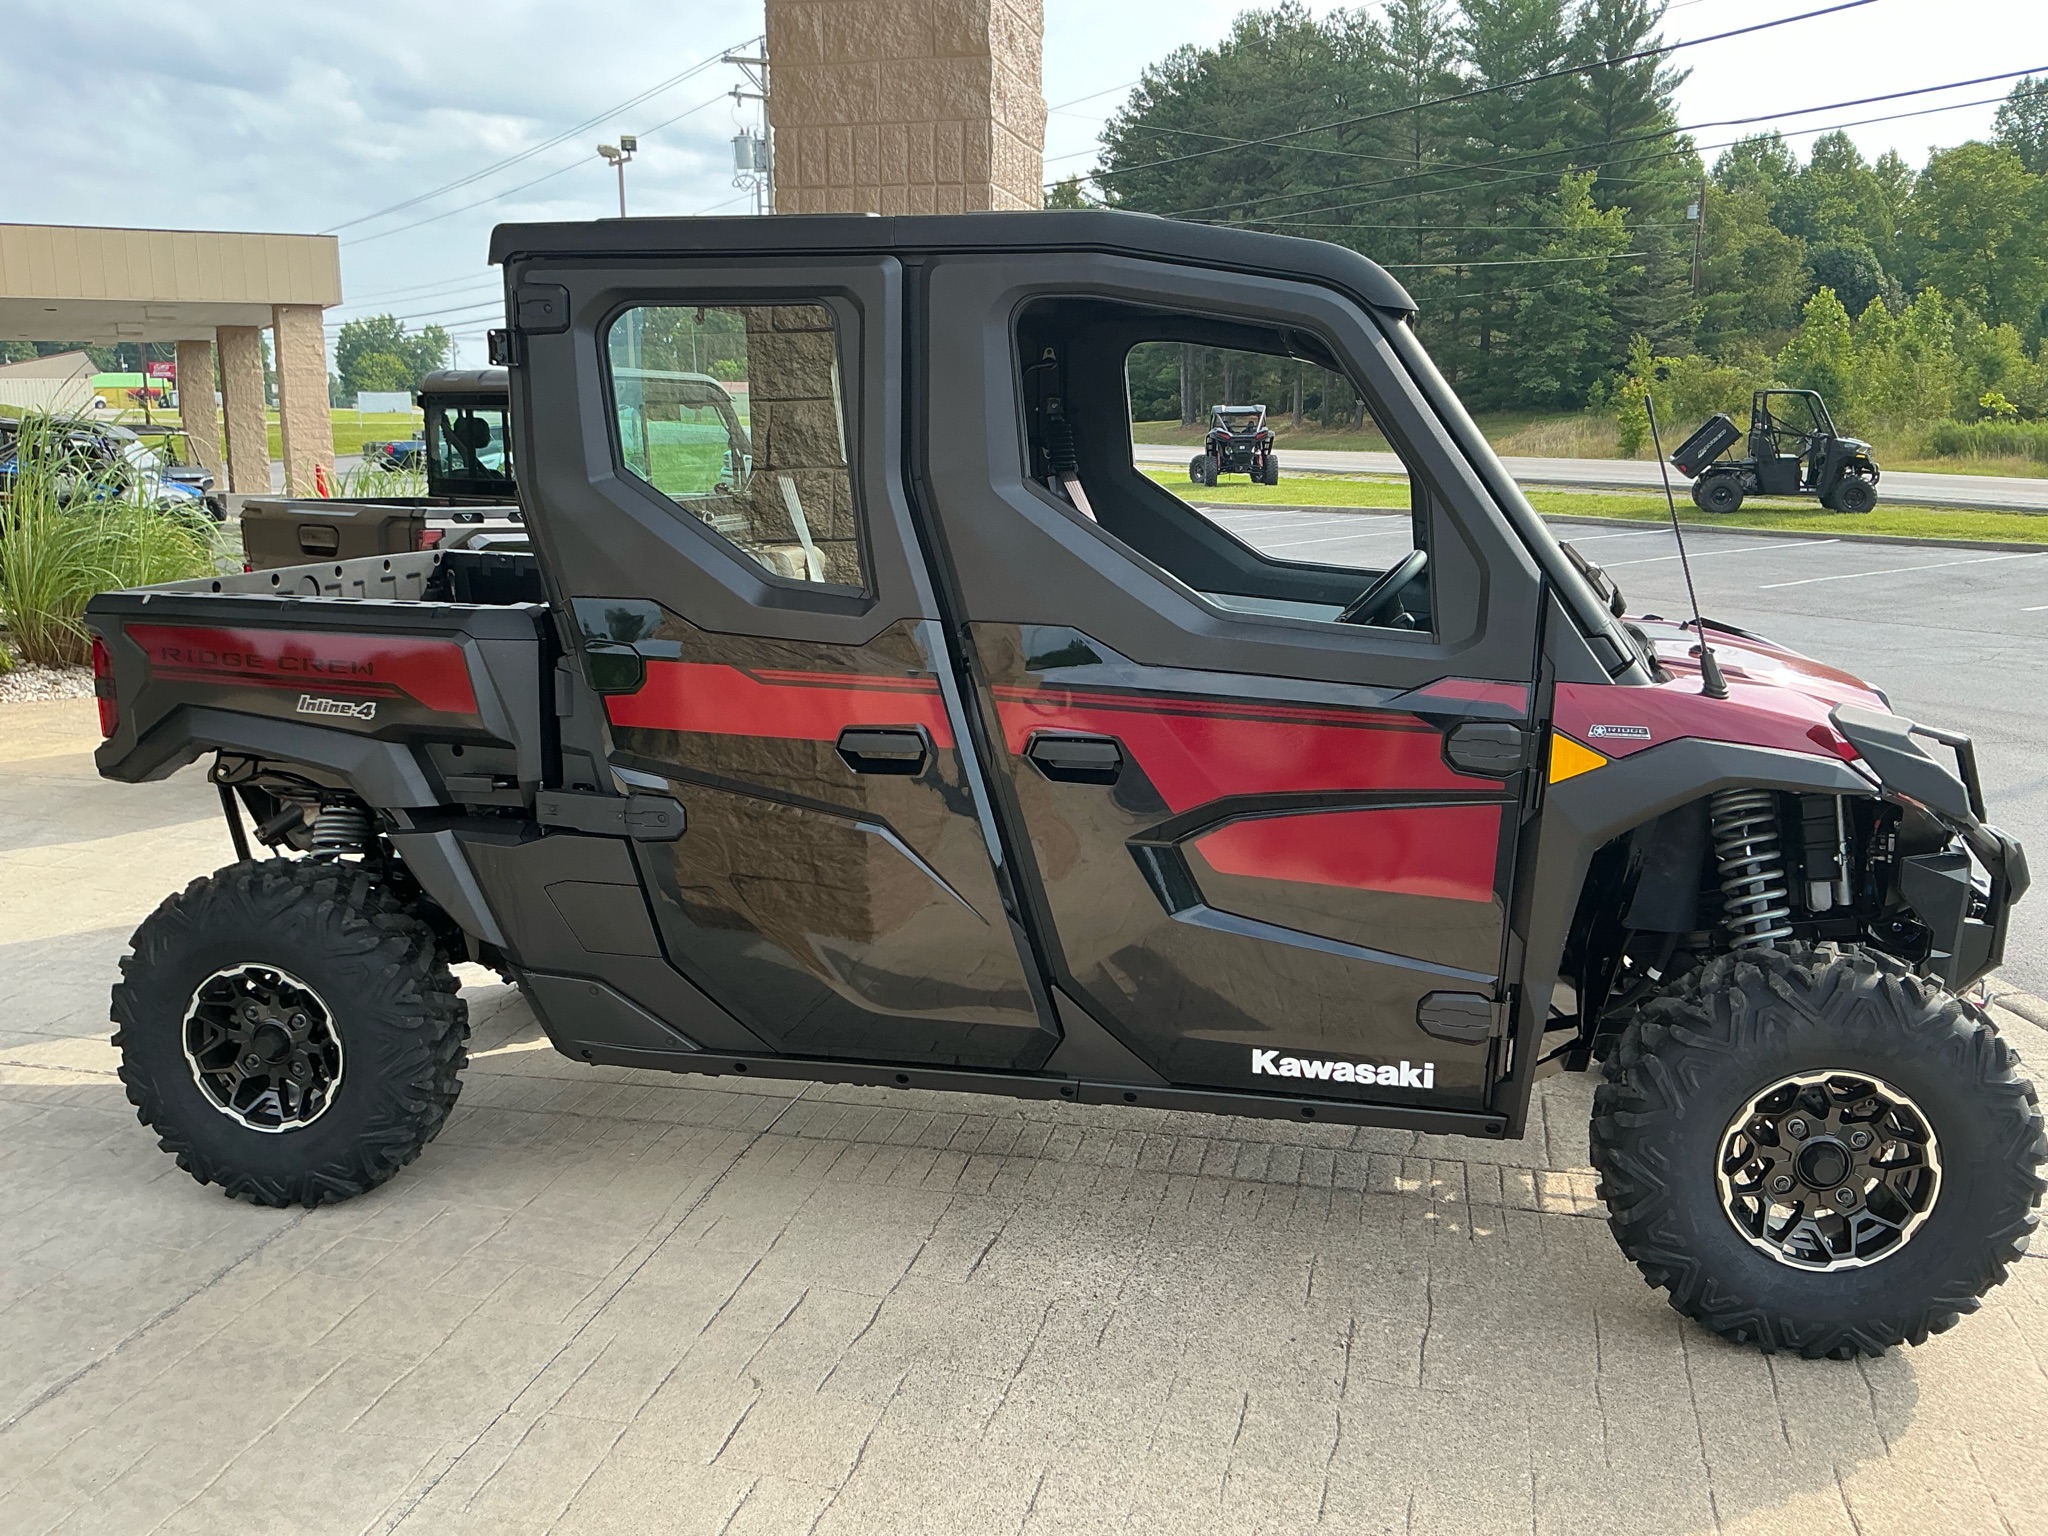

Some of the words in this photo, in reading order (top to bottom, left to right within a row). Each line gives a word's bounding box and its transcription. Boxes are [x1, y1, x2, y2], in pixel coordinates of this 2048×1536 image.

[161, 647, 265, 669] RIDGE
[277, 656, 374, 676] CREW
[296, 694, 377, 720] Inline-4
[1252, 1048, 1435, 1089] Kawasaki
